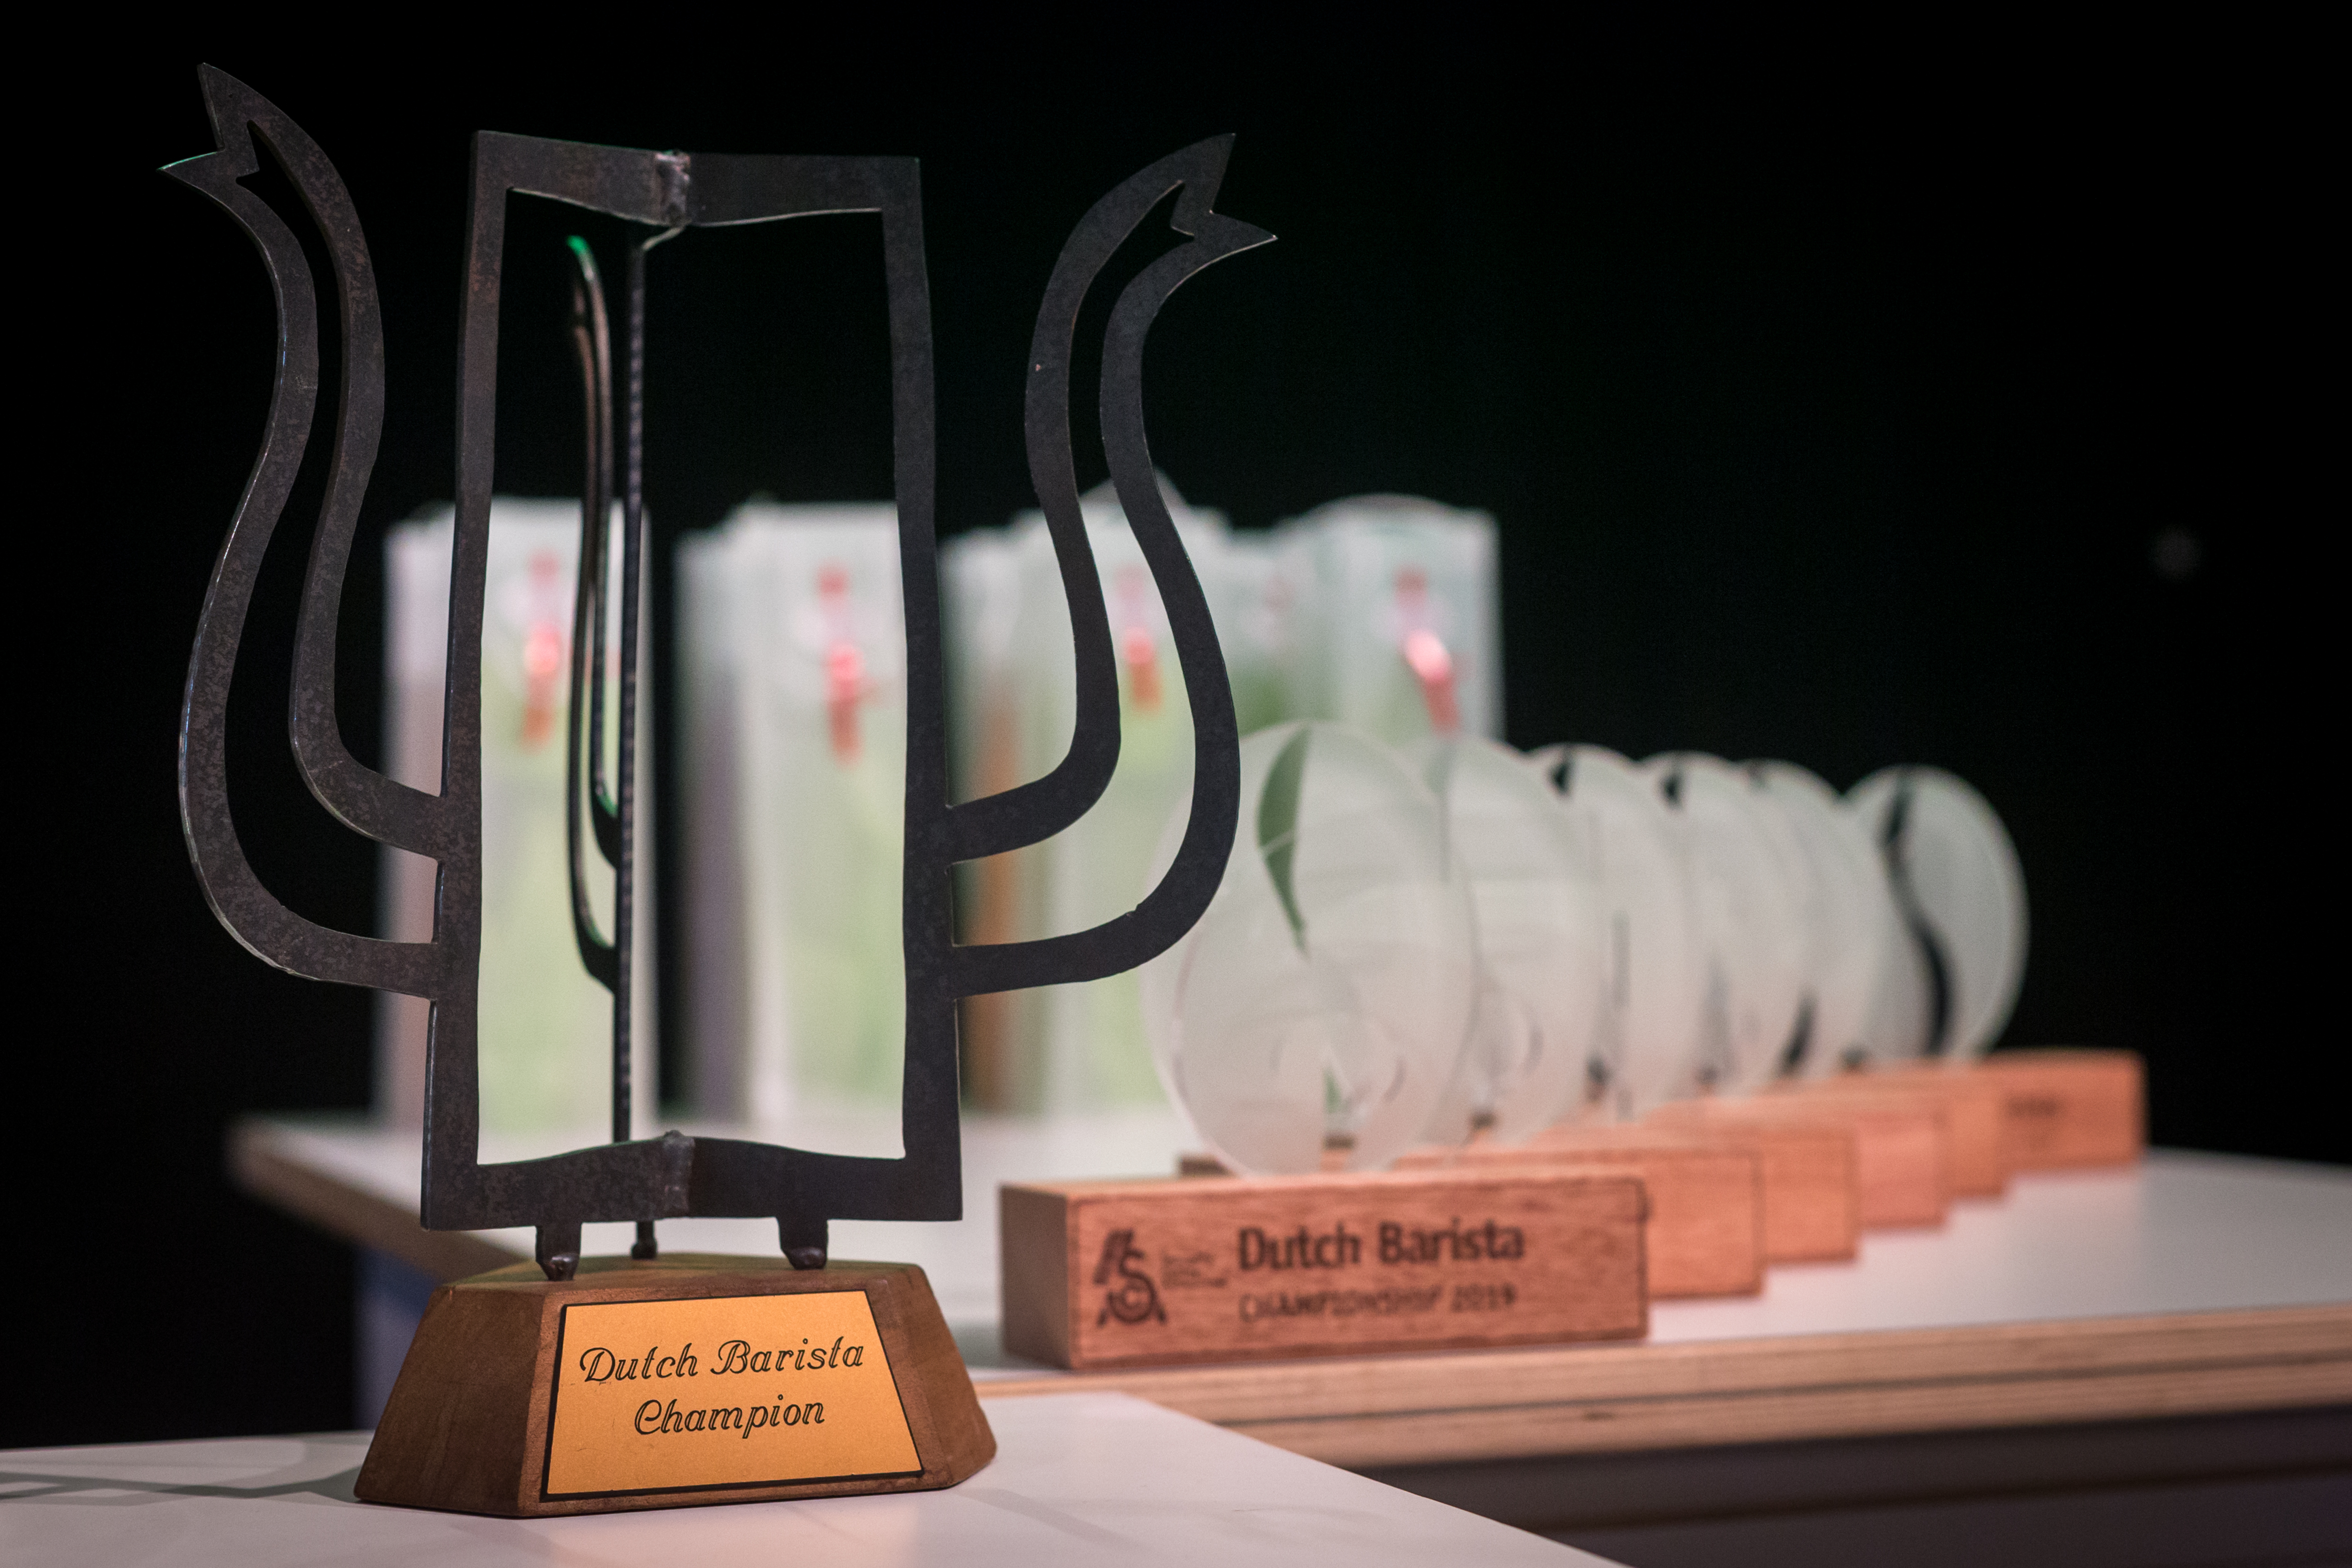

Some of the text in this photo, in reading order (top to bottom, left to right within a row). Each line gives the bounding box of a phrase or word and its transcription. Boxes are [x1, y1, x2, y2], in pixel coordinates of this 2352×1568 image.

[1238, 1222, 1362, 1271] Dutch
[1377, 1217, 1525, 1266] Barista
[579, 1336, 864, 1382] Dutch Barista
[634, 1394, 825, 1439] Champion
